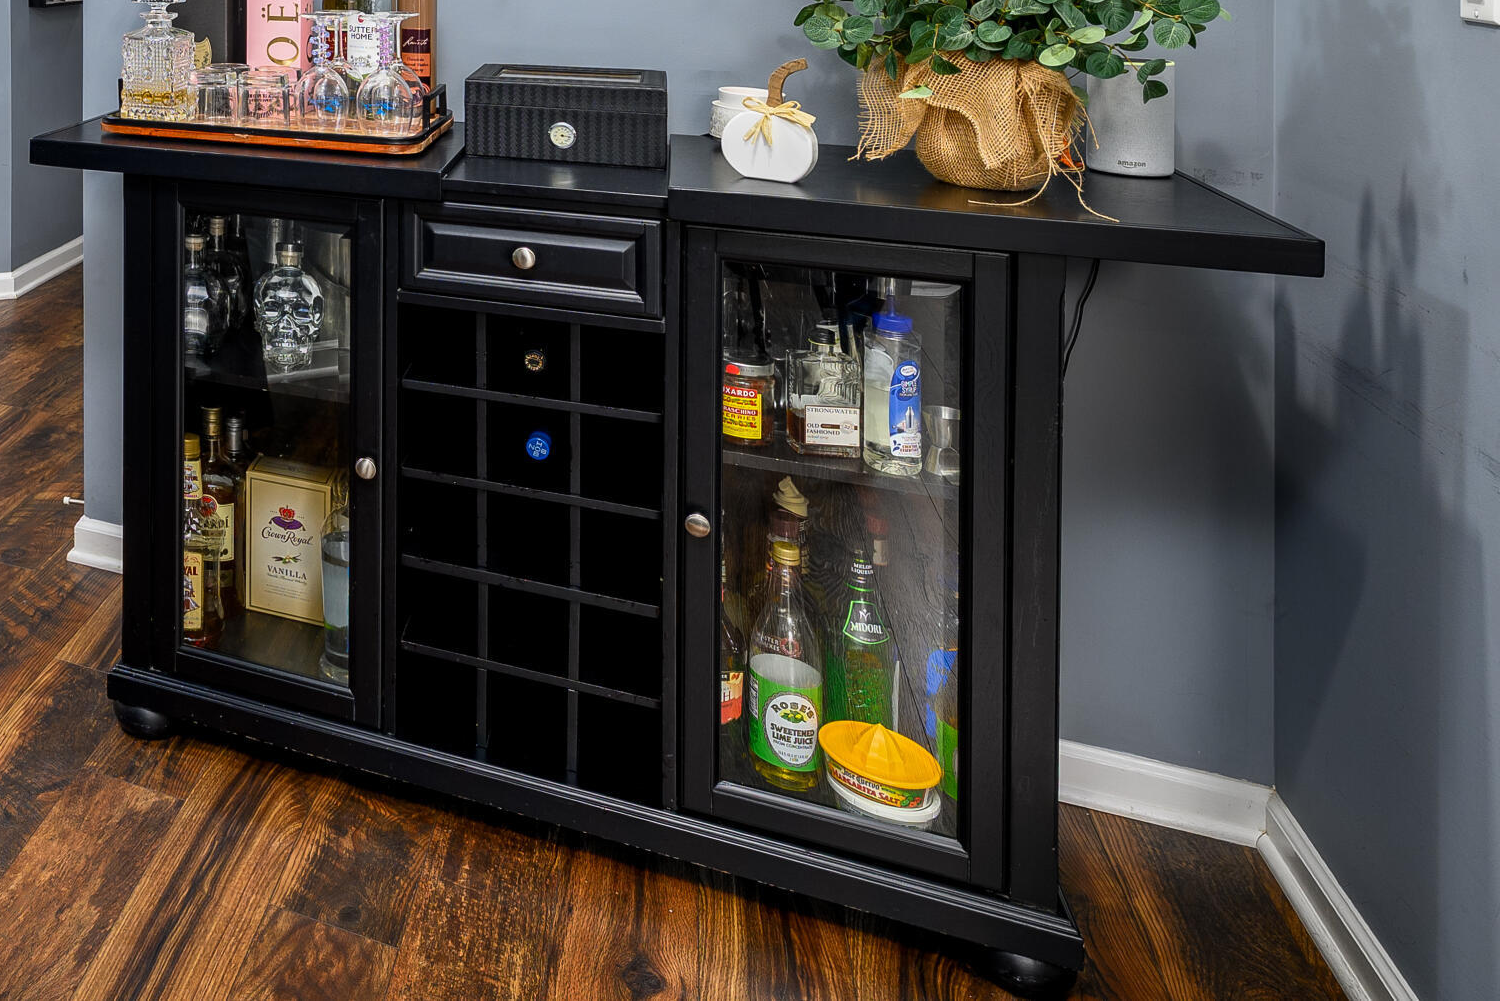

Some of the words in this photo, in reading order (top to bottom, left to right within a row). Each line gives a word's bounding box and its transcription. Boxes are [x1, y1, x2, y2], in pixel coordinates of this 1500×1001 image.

[723, 386, 755, 397] XARDO
[723, 405, 756, 415] RASCHINO
[261, 526, 286, 543] Crown
[283, 531, 313, 546] Royal
[267, 565, 308, 580] VANILLA
[850, 621, 883, 634] MIDORI
[771, 702, 815, 719] ROSE'S
[770, 722, 815, 737] SWEETENED
[772, 730, 792, 743] LIME
[794, 737, 813, 745] JUICE
